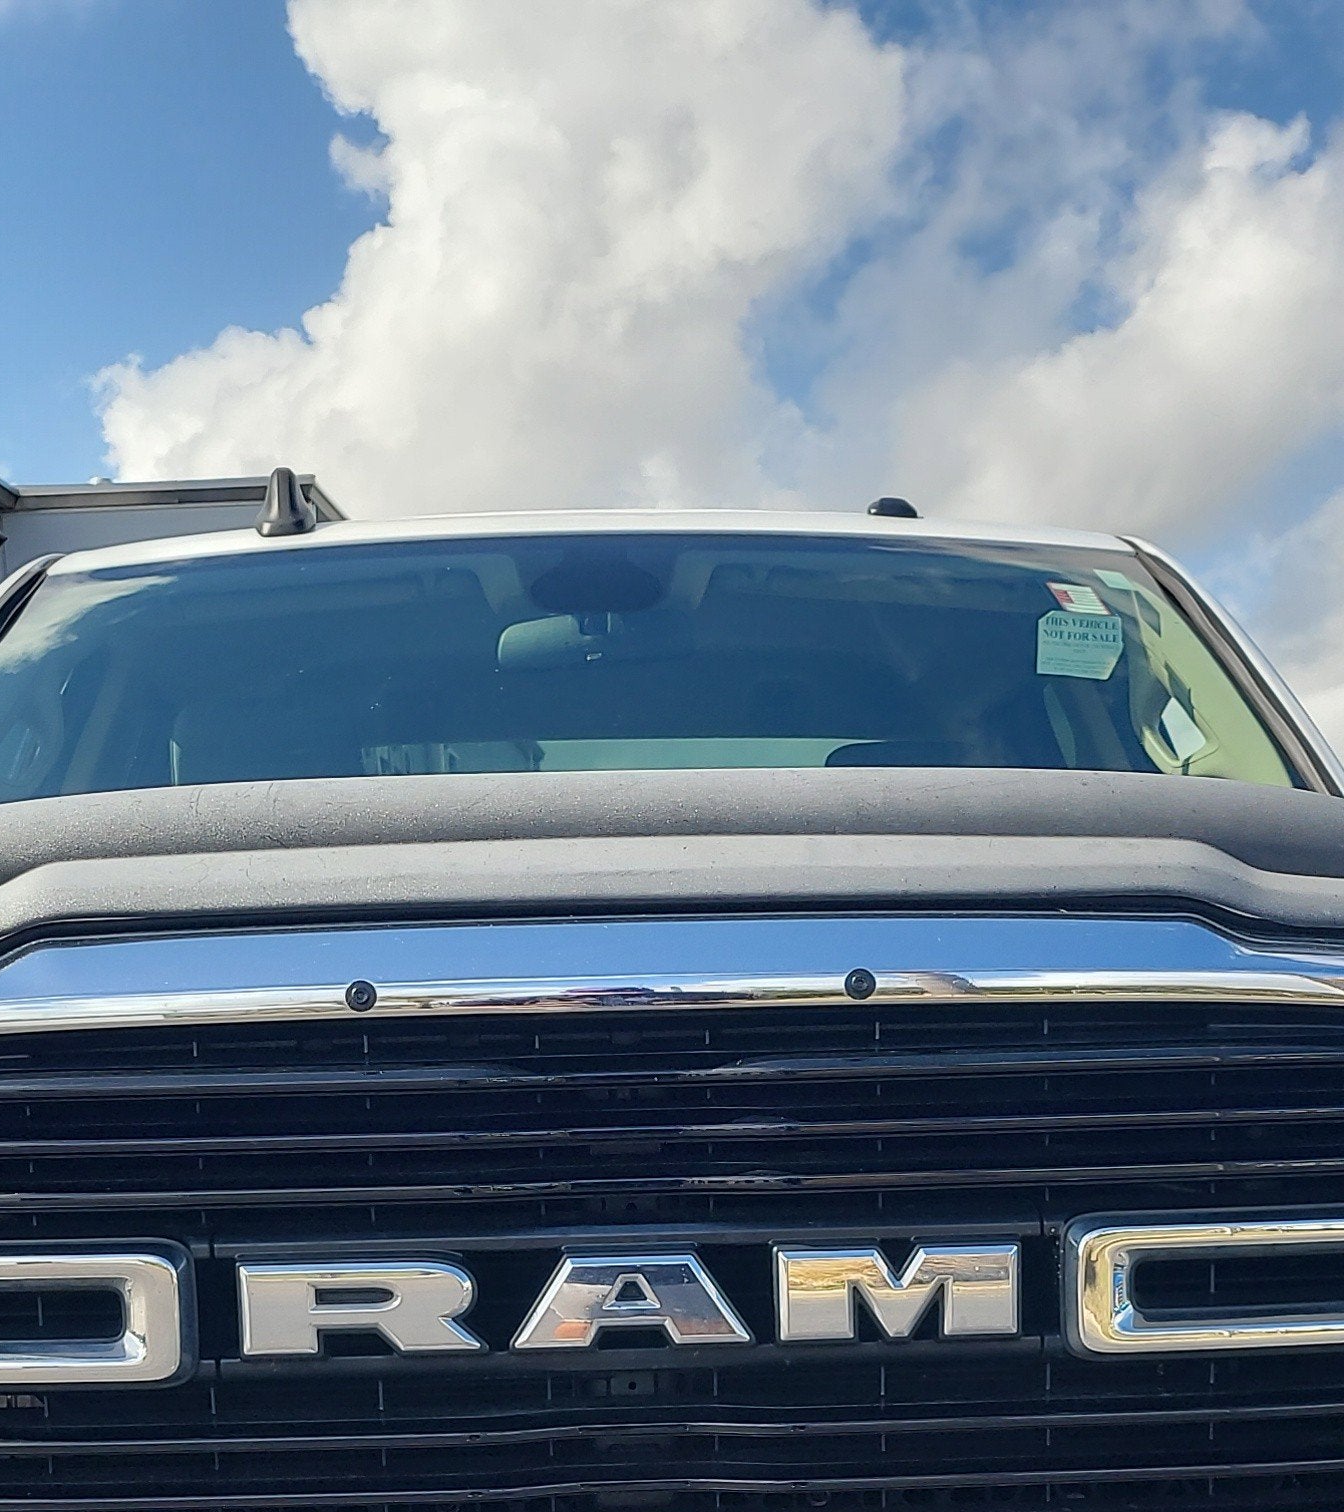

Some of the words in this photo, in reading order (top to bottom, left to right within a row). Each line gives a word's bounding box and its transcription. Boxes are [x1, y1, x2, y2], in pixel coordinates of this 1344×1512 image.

[1045, 616, 1069, 627] THIS
[1071, 618, 1119, 631] VEHICLE
[1043, 629, 1065, 640] NOT
[1067, 631, 1090, 641] FOR
[1091, 633, 1120, 643] SALE
[237, 1243, 1021, 1358] RAM
